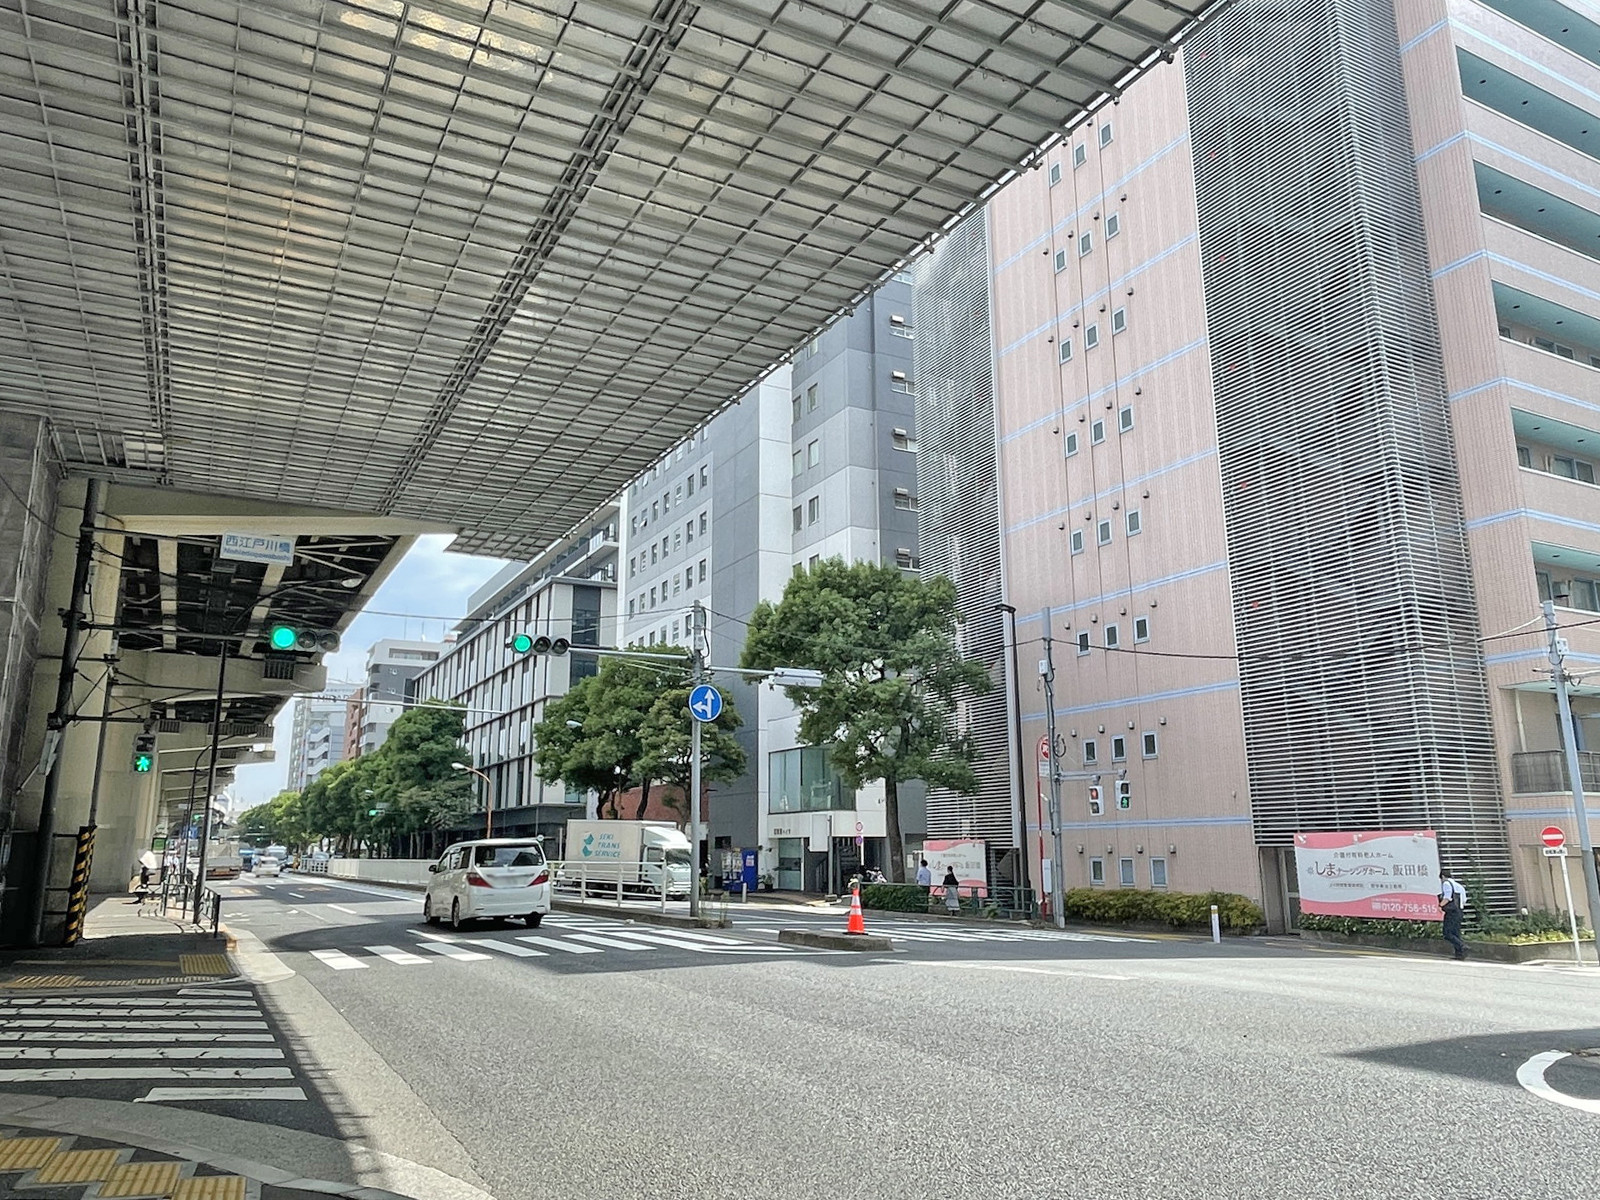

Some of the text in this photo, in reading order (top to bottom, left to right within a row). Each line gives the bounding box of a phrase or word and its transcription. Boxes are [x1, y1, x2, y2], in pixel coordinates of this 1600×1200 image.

[595, 850, 621, 858] SERVICE
[1392, 864, 1429, 877] 飯田橋
